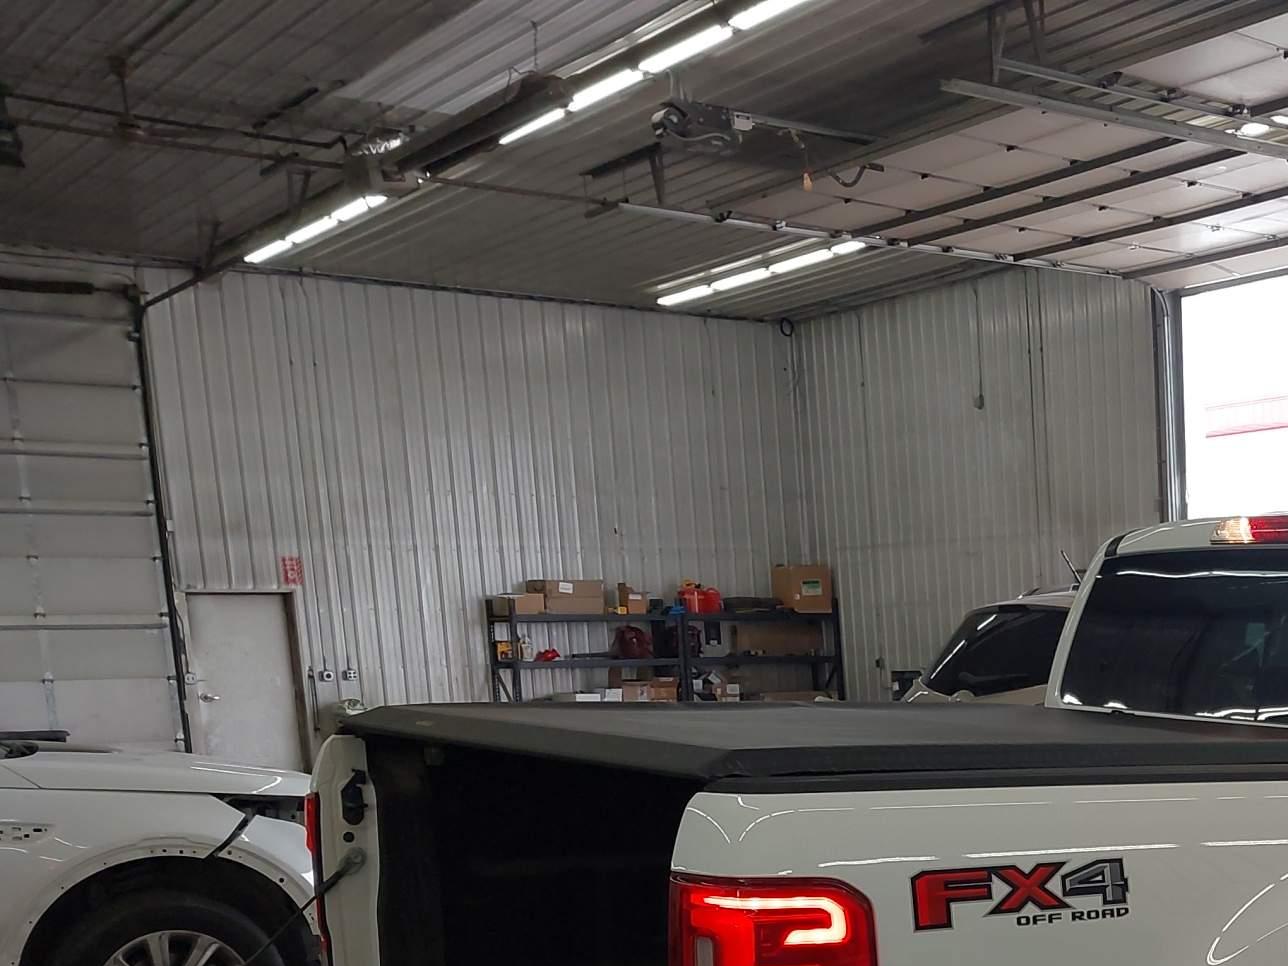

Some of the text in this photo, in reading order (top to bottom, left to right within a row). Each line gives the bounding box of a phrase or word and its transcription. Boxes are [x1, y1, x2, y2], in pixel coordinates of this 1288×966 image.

[910, 858, 1129, 932] FX4
[1016, 907, 1130, 927] OFF ROAD
